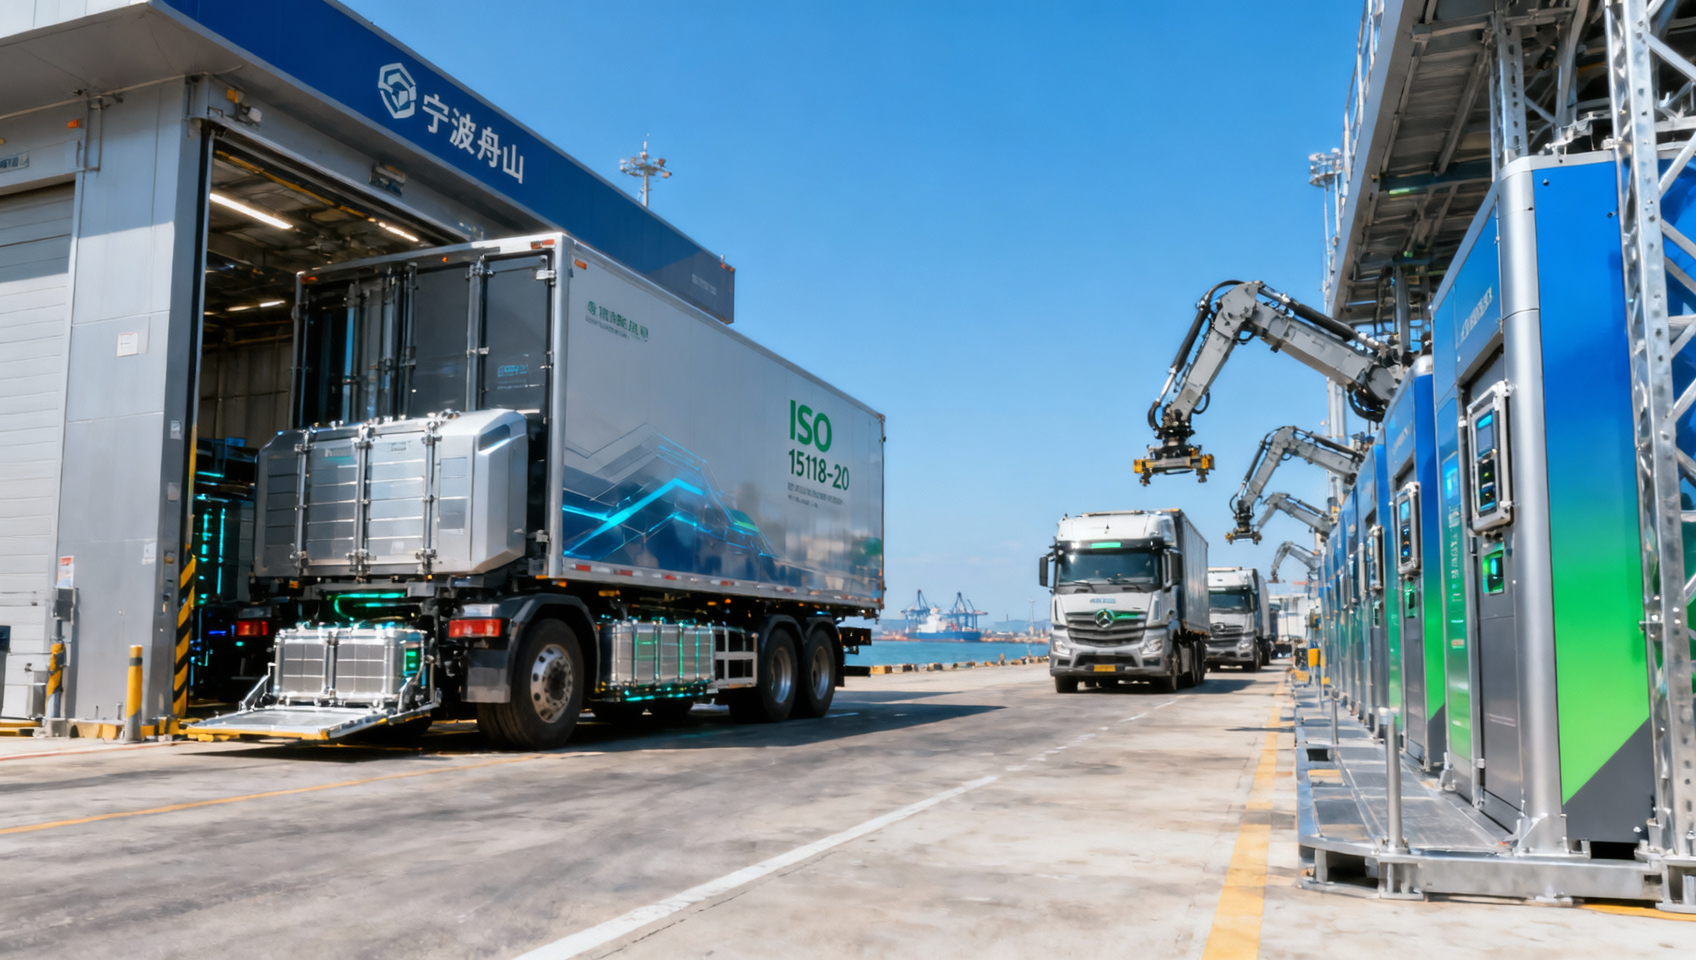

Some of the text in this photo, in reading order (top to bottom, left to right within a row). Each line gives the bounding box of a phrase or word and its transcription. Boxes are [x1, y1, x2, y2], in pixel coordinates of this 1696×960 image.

[422, 94, 524, 184] 宁波舟山
[790, 399, 832, 453] ISO
[788, 448, 850, 491] 15118-20
